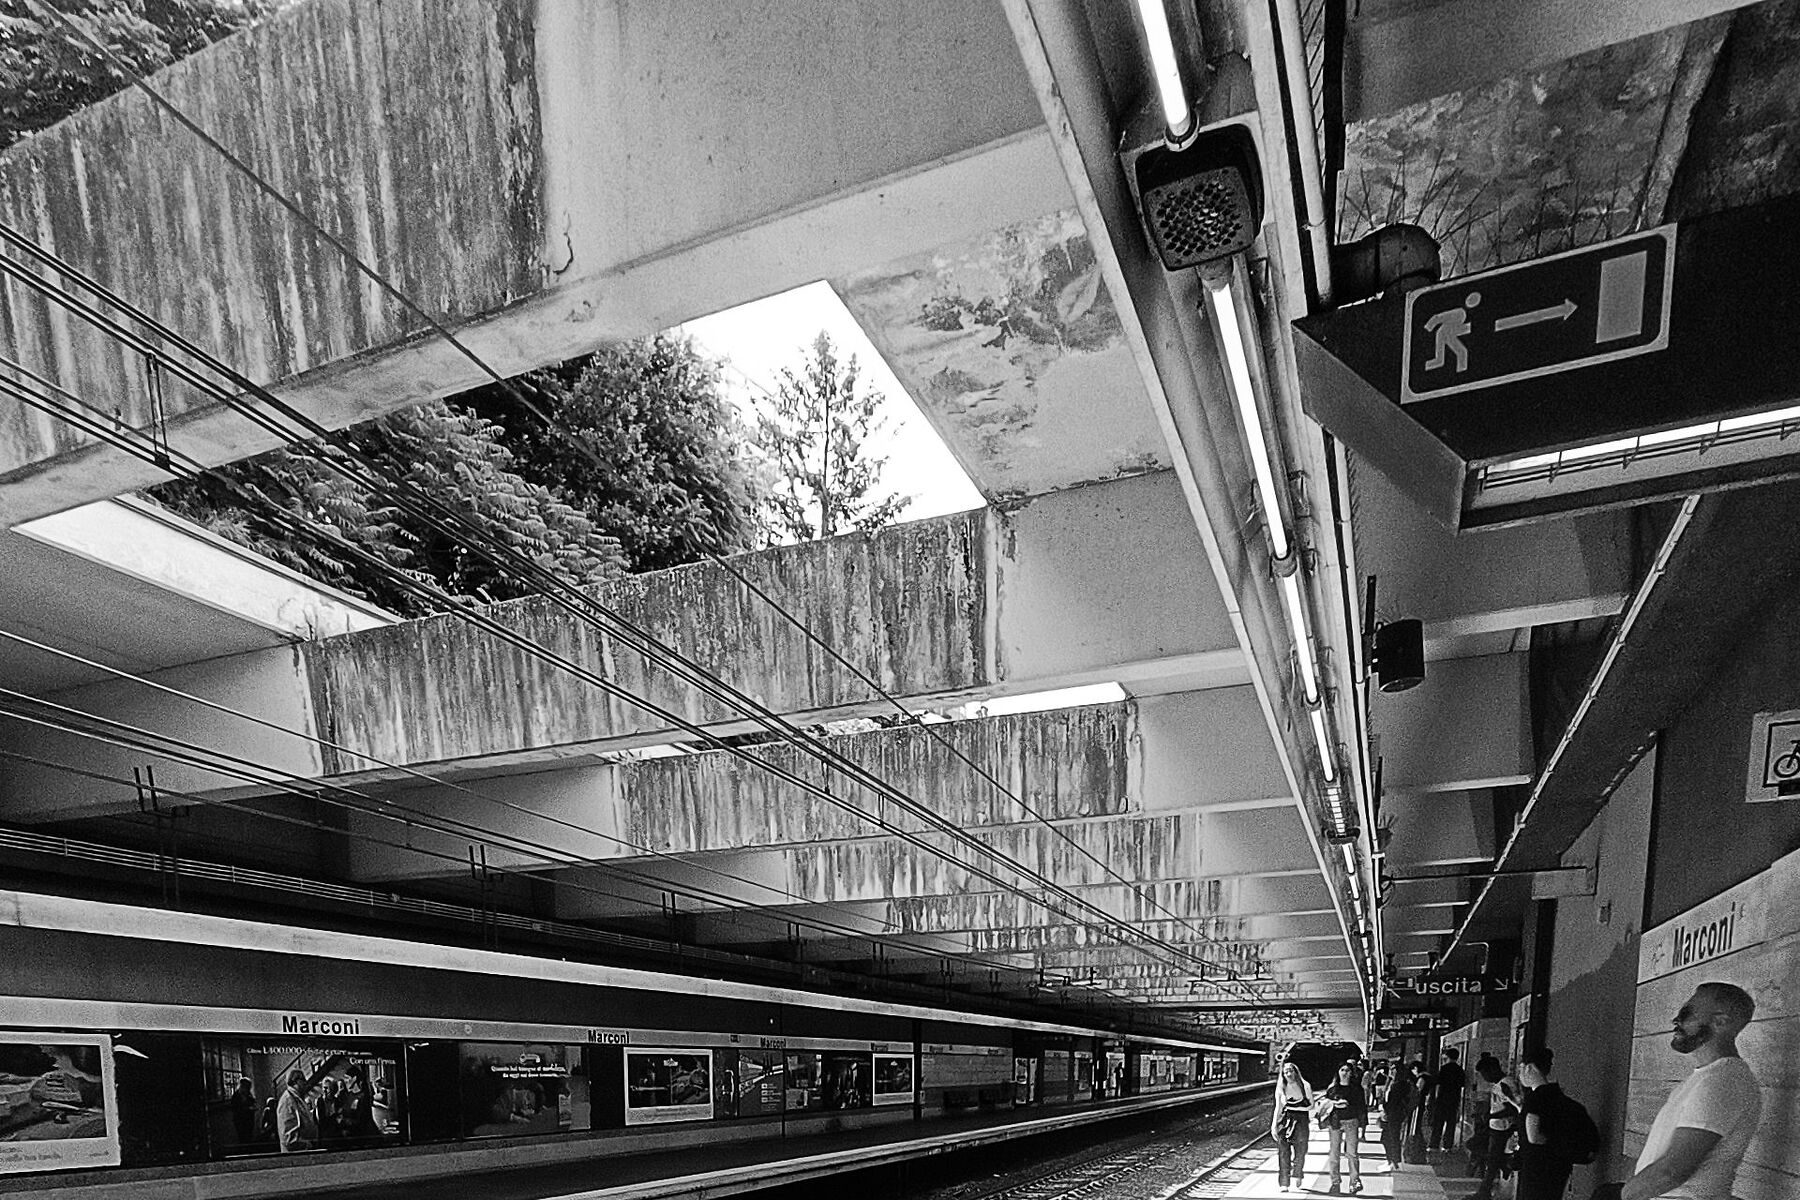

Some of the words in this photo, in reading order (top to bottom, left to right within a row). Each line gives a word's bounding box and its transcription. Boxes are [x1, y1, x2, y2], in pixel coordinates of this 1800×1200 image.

[1672, 901, 1735, 968] Marconi
[1416, 977, 1481, 994] uscita
[282, 1015, 360, 1035] Marconi
[588, 1029, 630, 1044] Marconi
